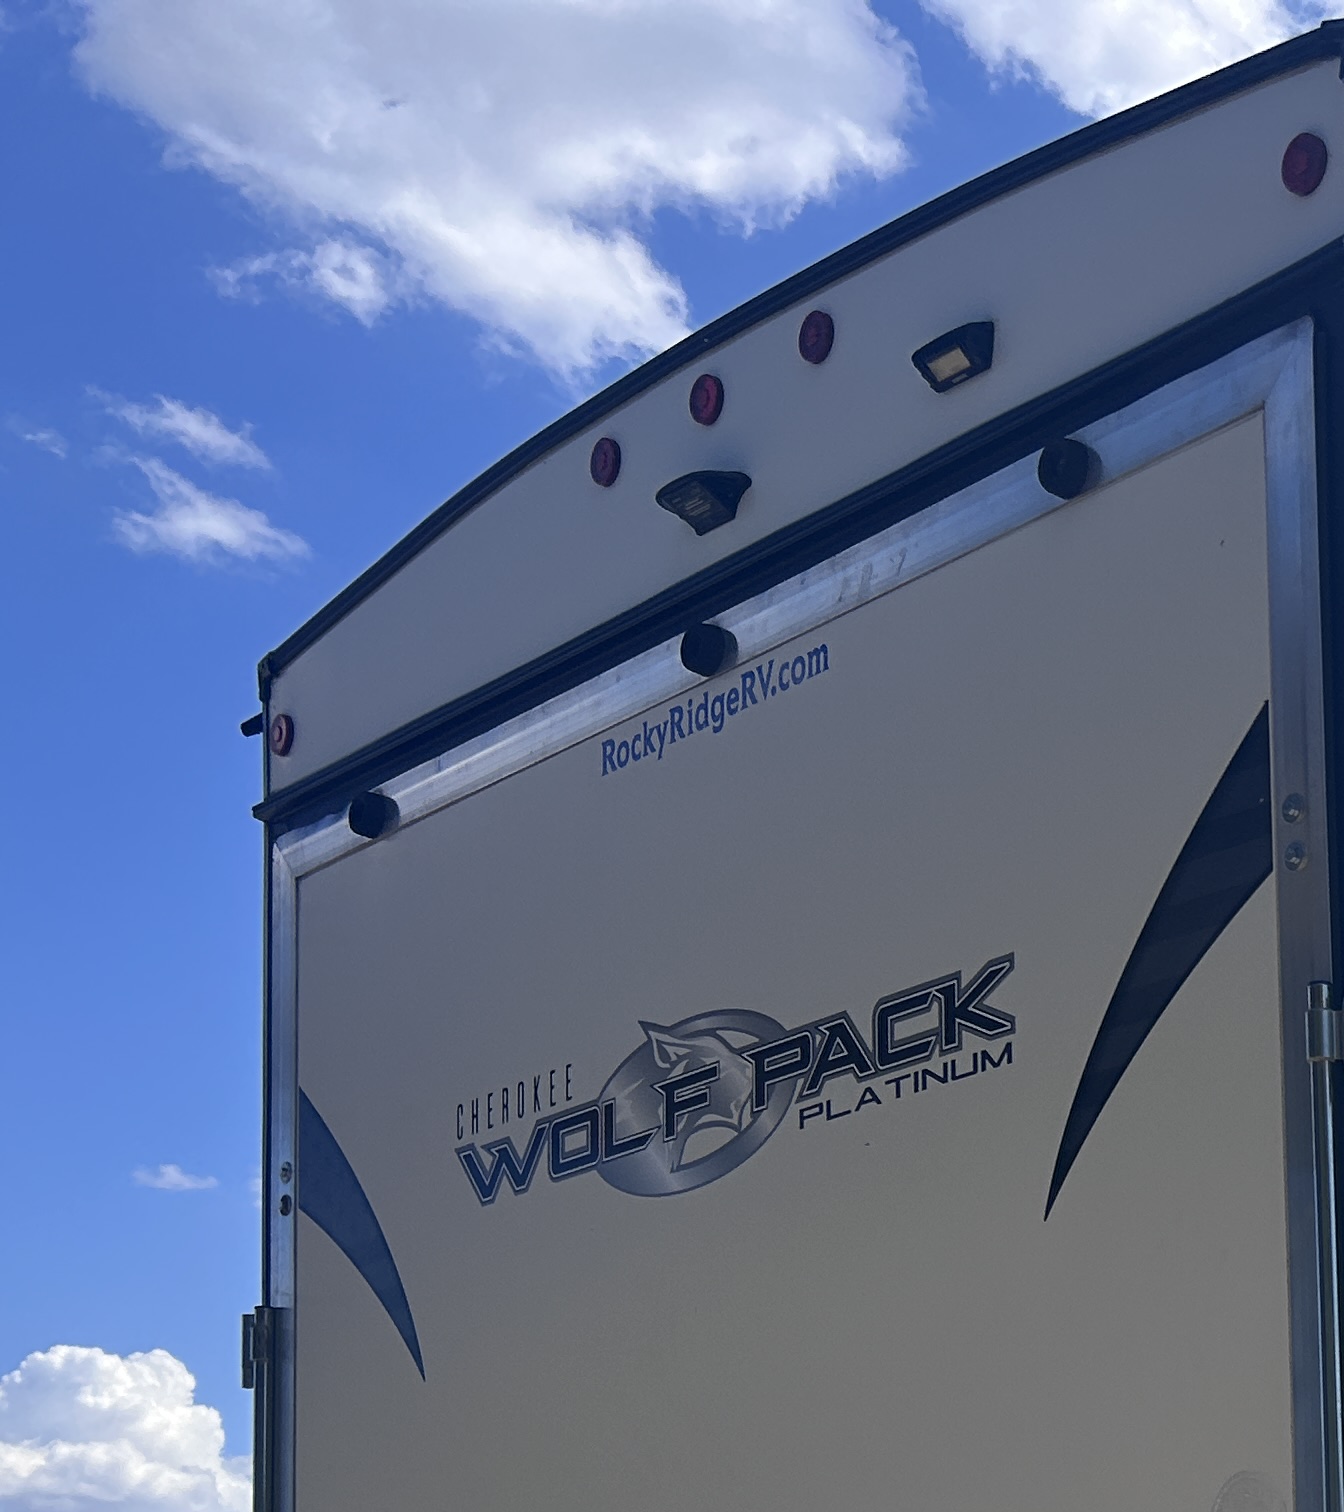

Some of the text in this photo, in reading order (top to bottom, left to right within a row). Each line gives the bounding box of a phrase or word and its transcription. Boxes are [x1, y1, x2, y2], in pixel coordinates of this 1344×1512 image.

[600, 641, 831, 777] RockyRidgeRV.com
[454, 952, 1016, 1207] WOLF PACK
[455, 1063, 575, 1142] CHEROKEE
[798, 1041, 1014, 1131] PLATINUM
